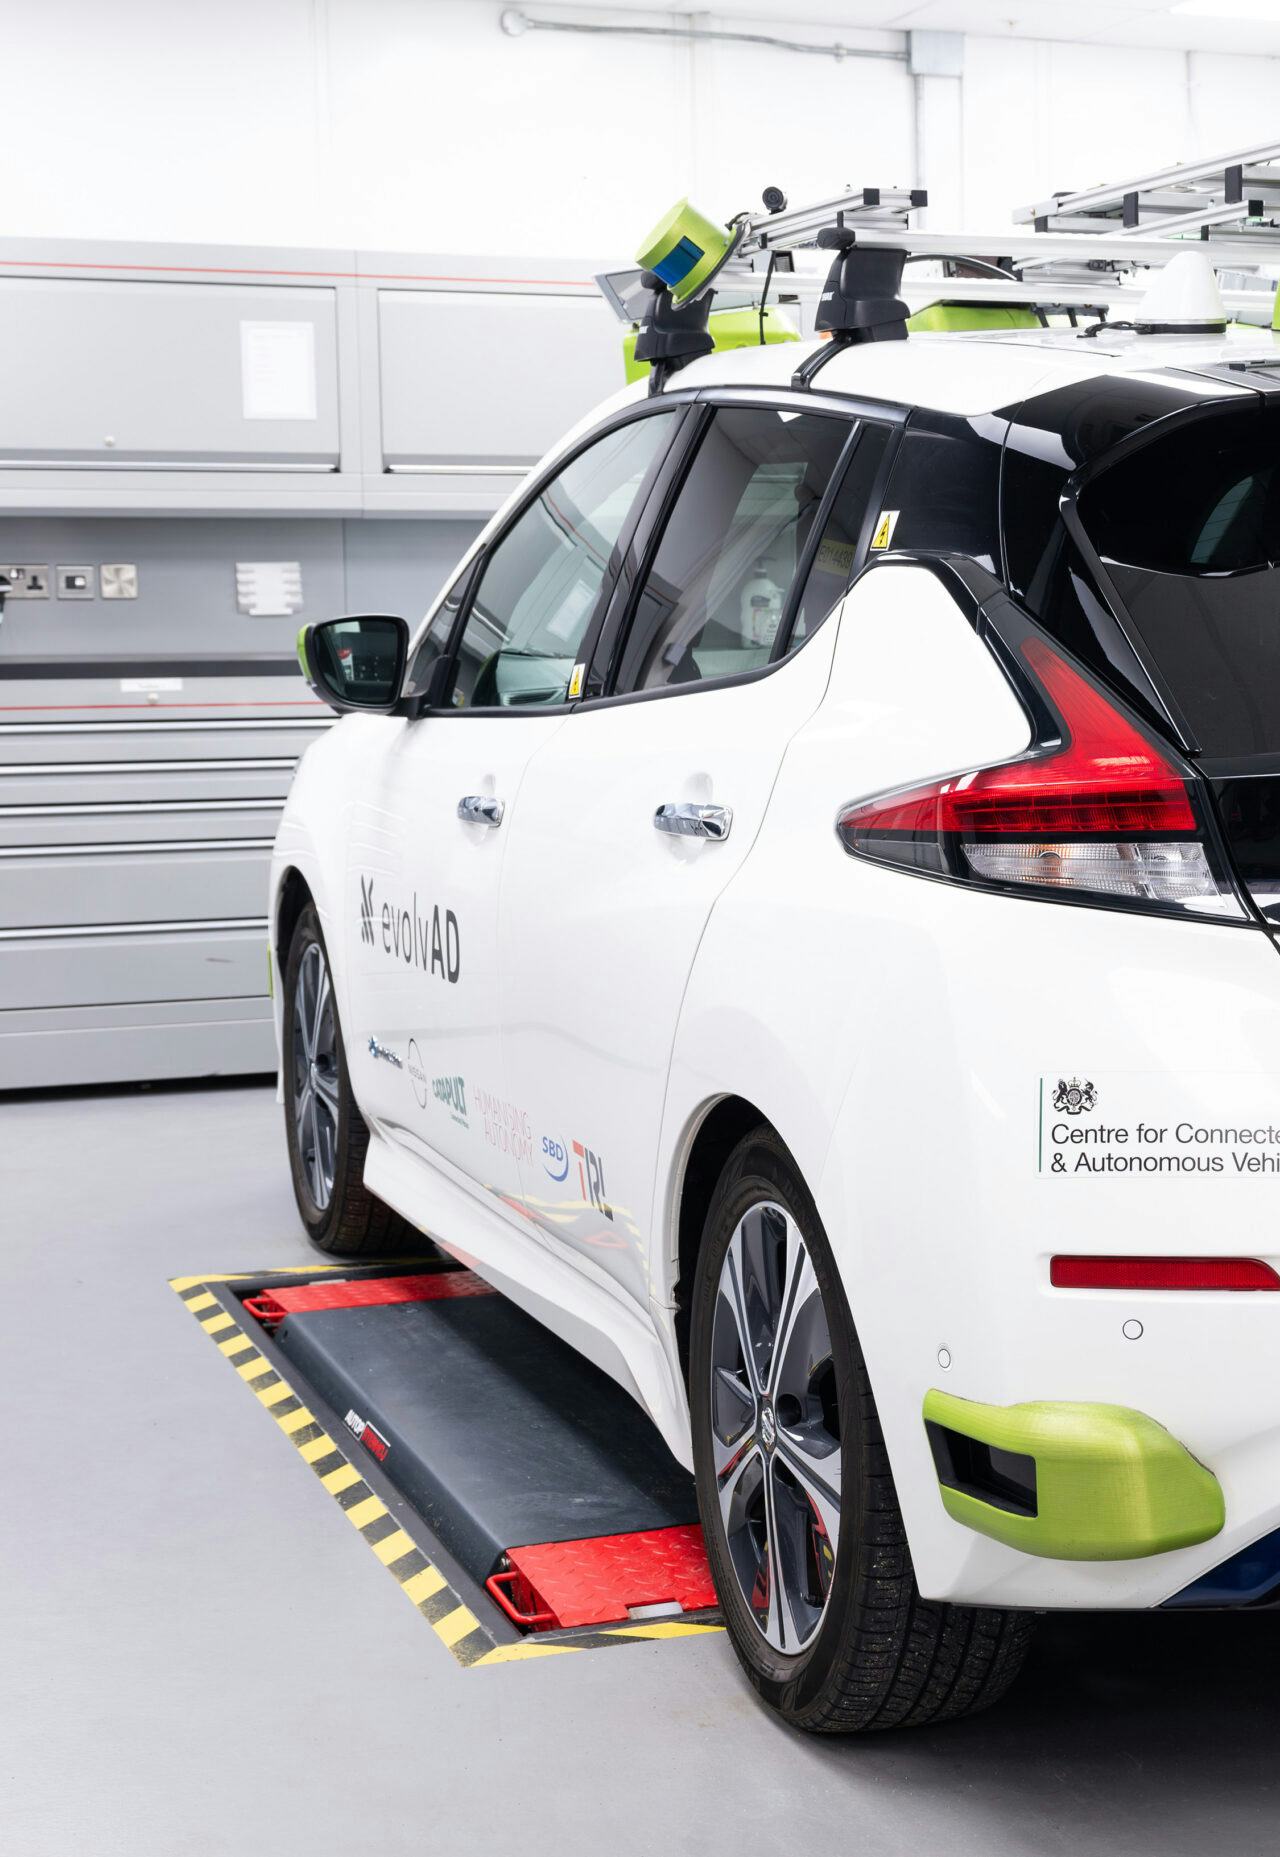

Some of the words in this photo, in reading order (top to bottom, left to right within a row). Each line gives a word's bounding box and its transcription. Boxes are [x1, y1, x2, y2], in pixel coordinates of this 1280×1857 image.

[382, 891, 460, 984] evolvAD
[432, 1076, 467, 1116] CATAPULT
[542, 1136, 564, 1162] SBD
[1051, 1123, 1129, 1145] Centre
[1136, 1123, 1168, 1144] for
[1050, 1152, 1068, 1173] &
[1074, 1152, 1224, 1172] Autonomous
[572, 1139, 614, 1222] TRL
